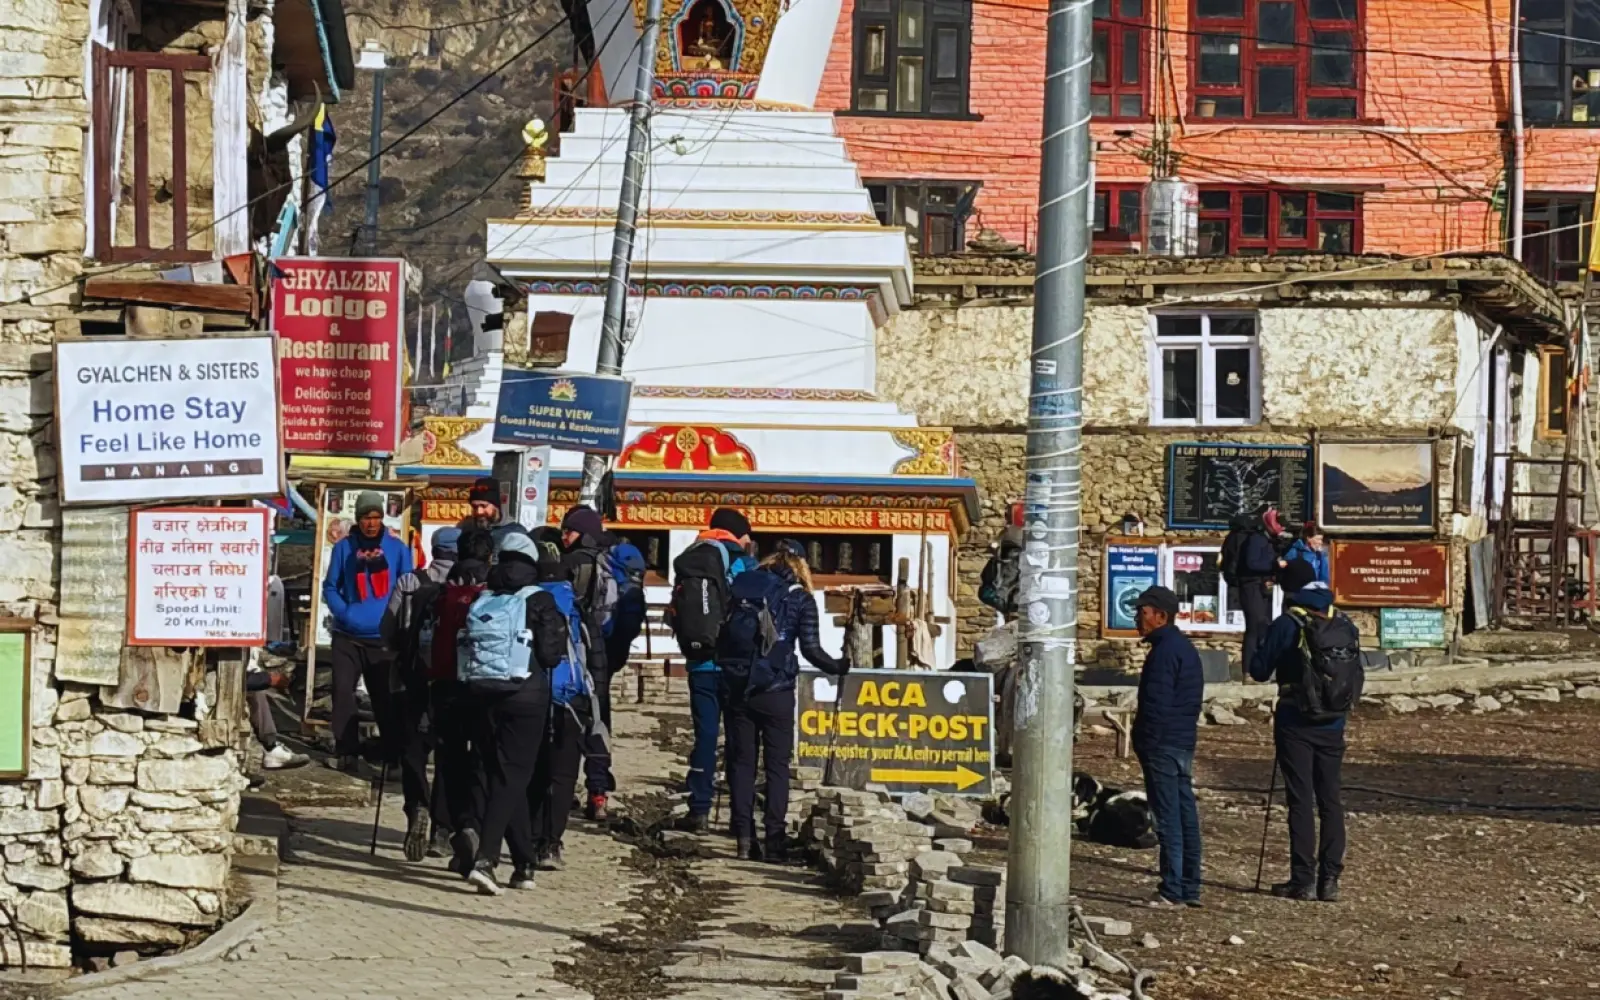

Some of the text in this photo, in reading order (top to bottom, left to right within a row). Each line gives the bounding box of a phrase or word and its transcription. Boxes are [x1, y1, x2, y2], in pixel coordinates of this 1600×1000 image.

[284, 294, 387, 320] Lodge
[329, 323, 341, 336] &
[280, 337, 390, 361] Restaurant
[77, 361, 260, 384] GYALCHEN & SISTERS
[295, 365, 371, 380] we have cheap
[295, 386, 371, 401] Delicious Food
[93, 396, 247, 424] Home Stay
[302, 404, 325, 414] View
[326, 405, 344, 415] Fire
[346, 406, 371, 415] Place
[528, 405, 593, 420] SUPER VIEW
[309, 417, 317, 426] &
[319, 418, 347, 427] Porter
[349, 419, 384, 428] Service
[500, 415, 527, 425] Guest
[528, 416, 556, 428] House
[559, 421, 566, 430] &
[80, 430, 261, 454] Feel Like Home
[285, 429, 379, 443] Laundry Service
[104, 462, 239, 478] MANANG
[152, 519, 190, 534] बजार
[220, 538, 260, 556] सवारी
[152, 560, 247, 576] चलाउन निषेध
[153, 581, 207, 601] गरिएको
[156, 604, 242, 615] Speed Limit:
[164, 617, 181, 626] 20
[857, 680, 927, 708] ACA
[801, 710, 988, 741] CHECK-POST
[799, 741, 829, 758] Please
[871, 747, 893, 761] your
[893, 744, 913, 760] ACA
[914, 746, 940, 763] entry
